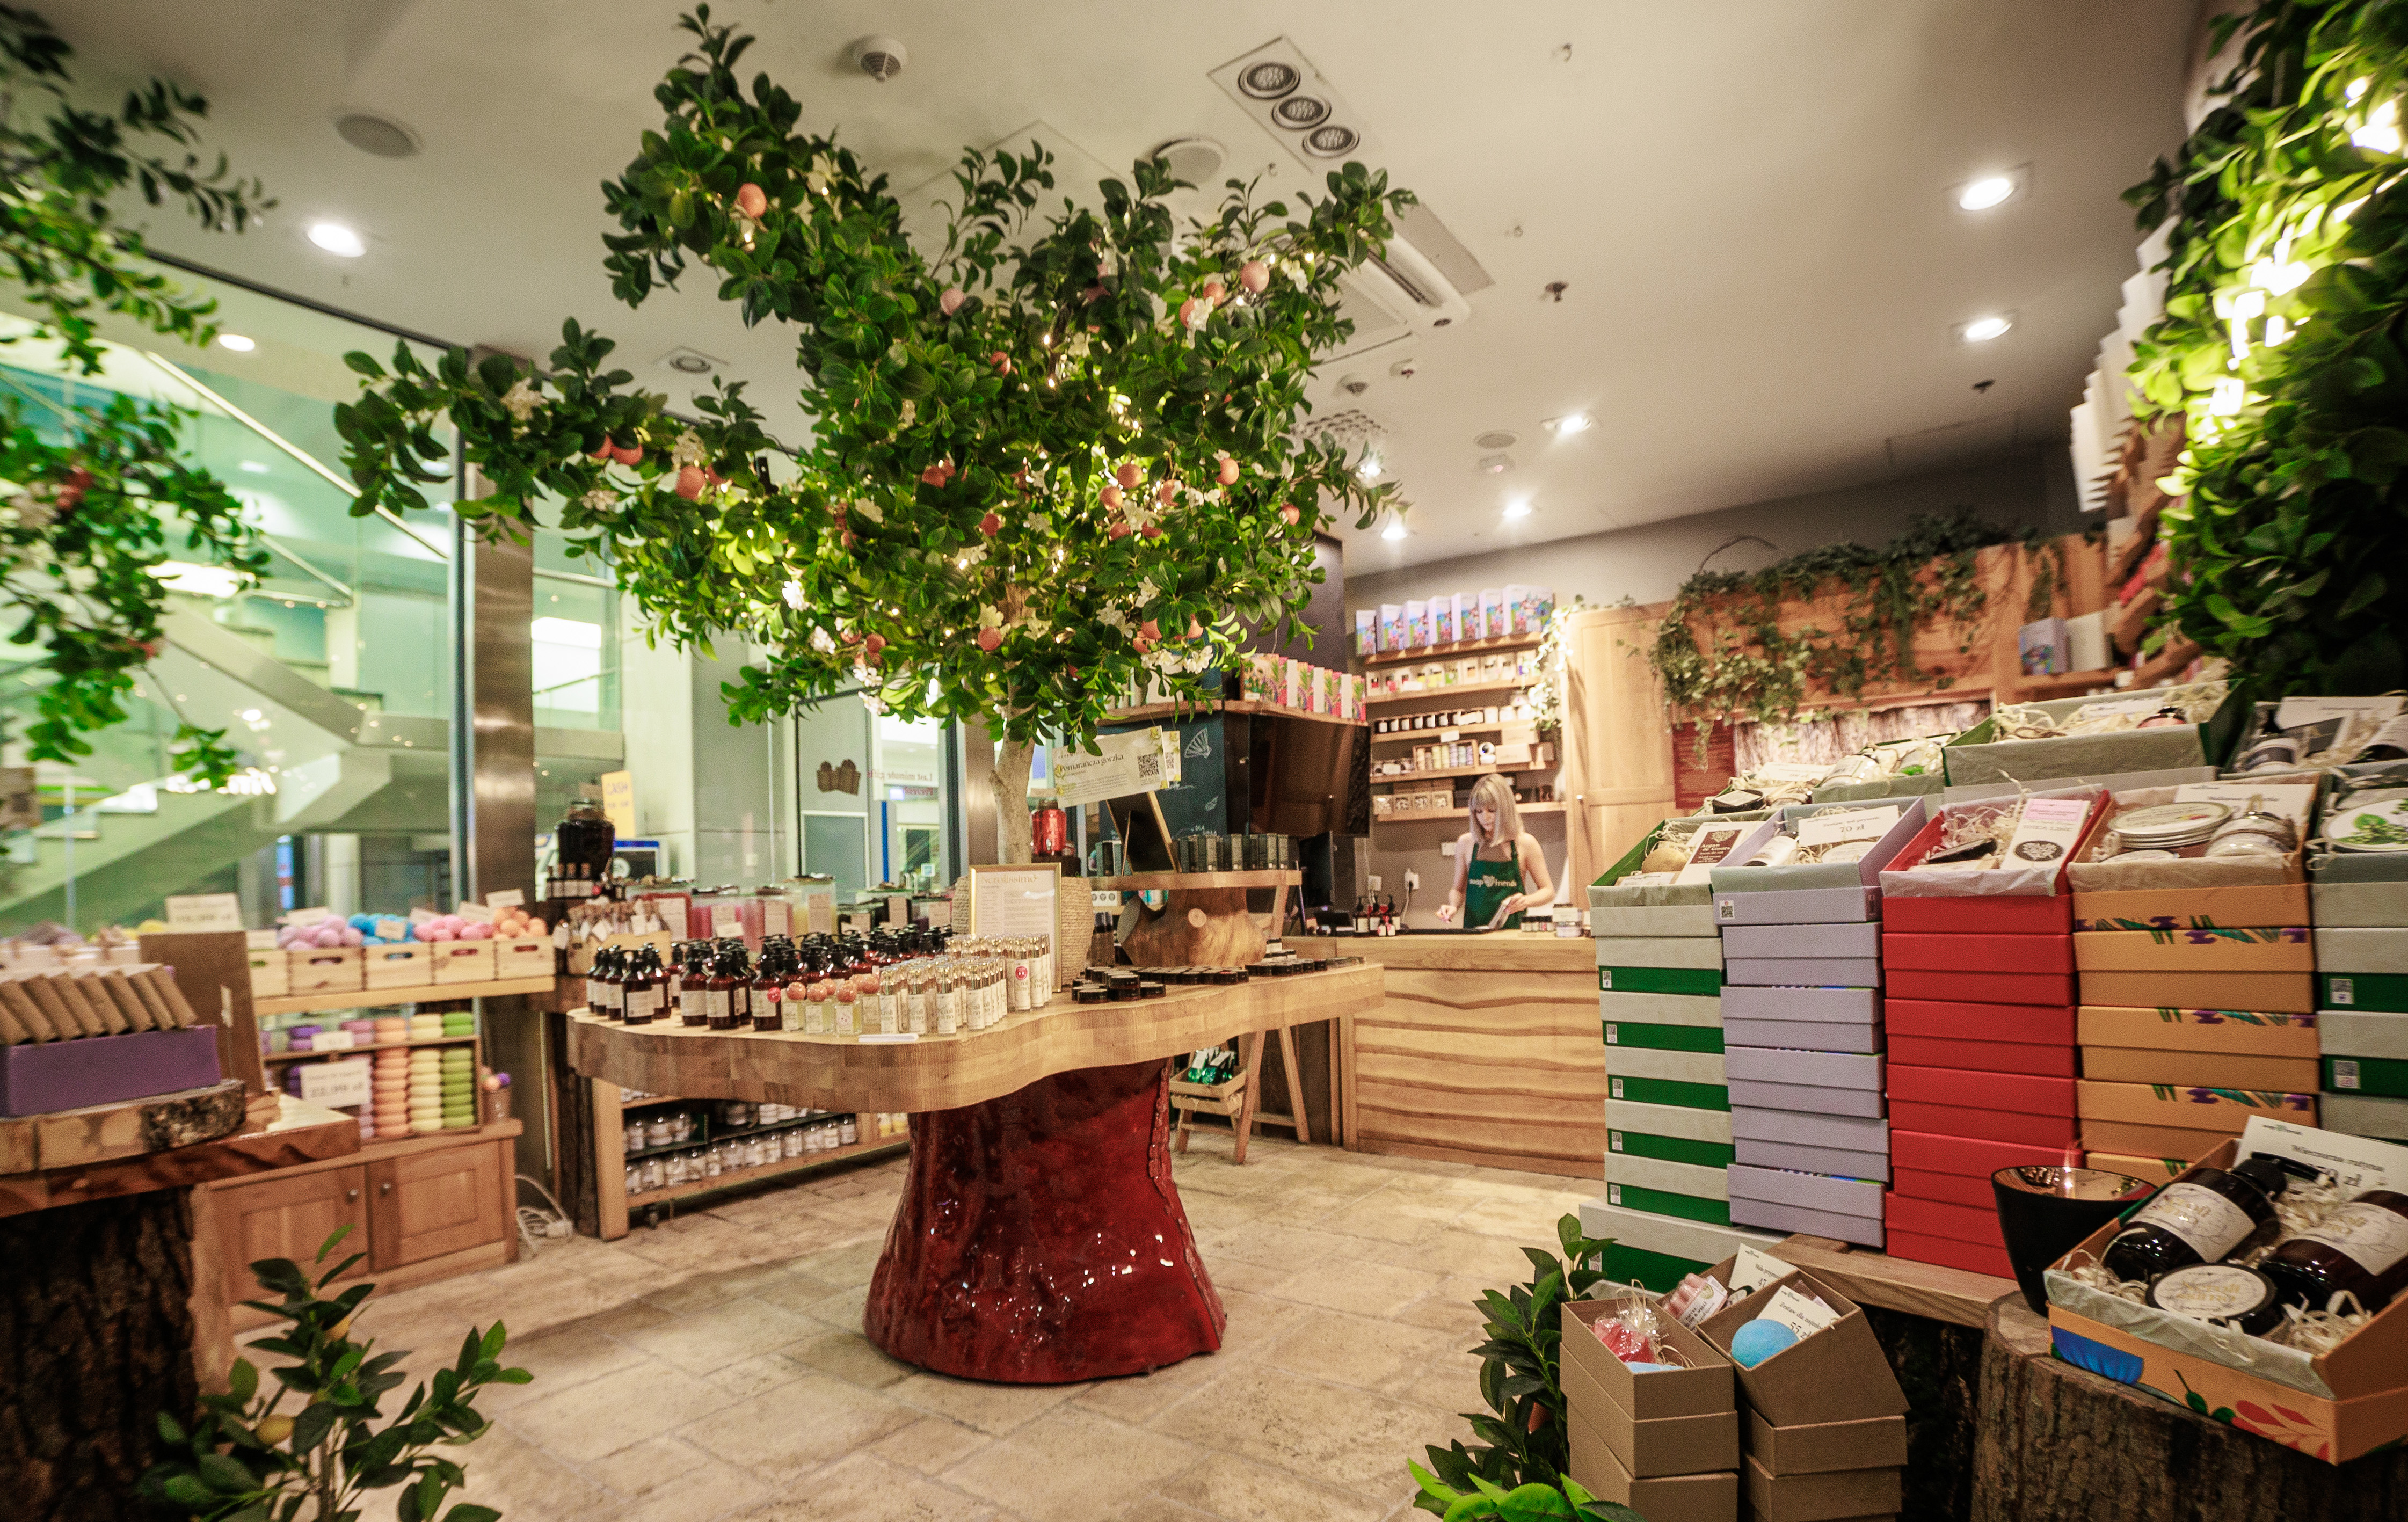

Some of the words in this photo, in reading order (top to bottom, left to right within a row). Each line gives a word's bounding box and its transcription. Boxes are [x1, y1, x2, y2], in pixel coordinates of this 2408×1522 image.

[1101, 754, 1124, 766] gorzka
[2343, 1173, 2362, 1187] zł
[1758, 1277, 1767, 1287] 47
[1790, 1322, 1802, 1334] 55
[1800, 1331, 1812, 1339] zł
